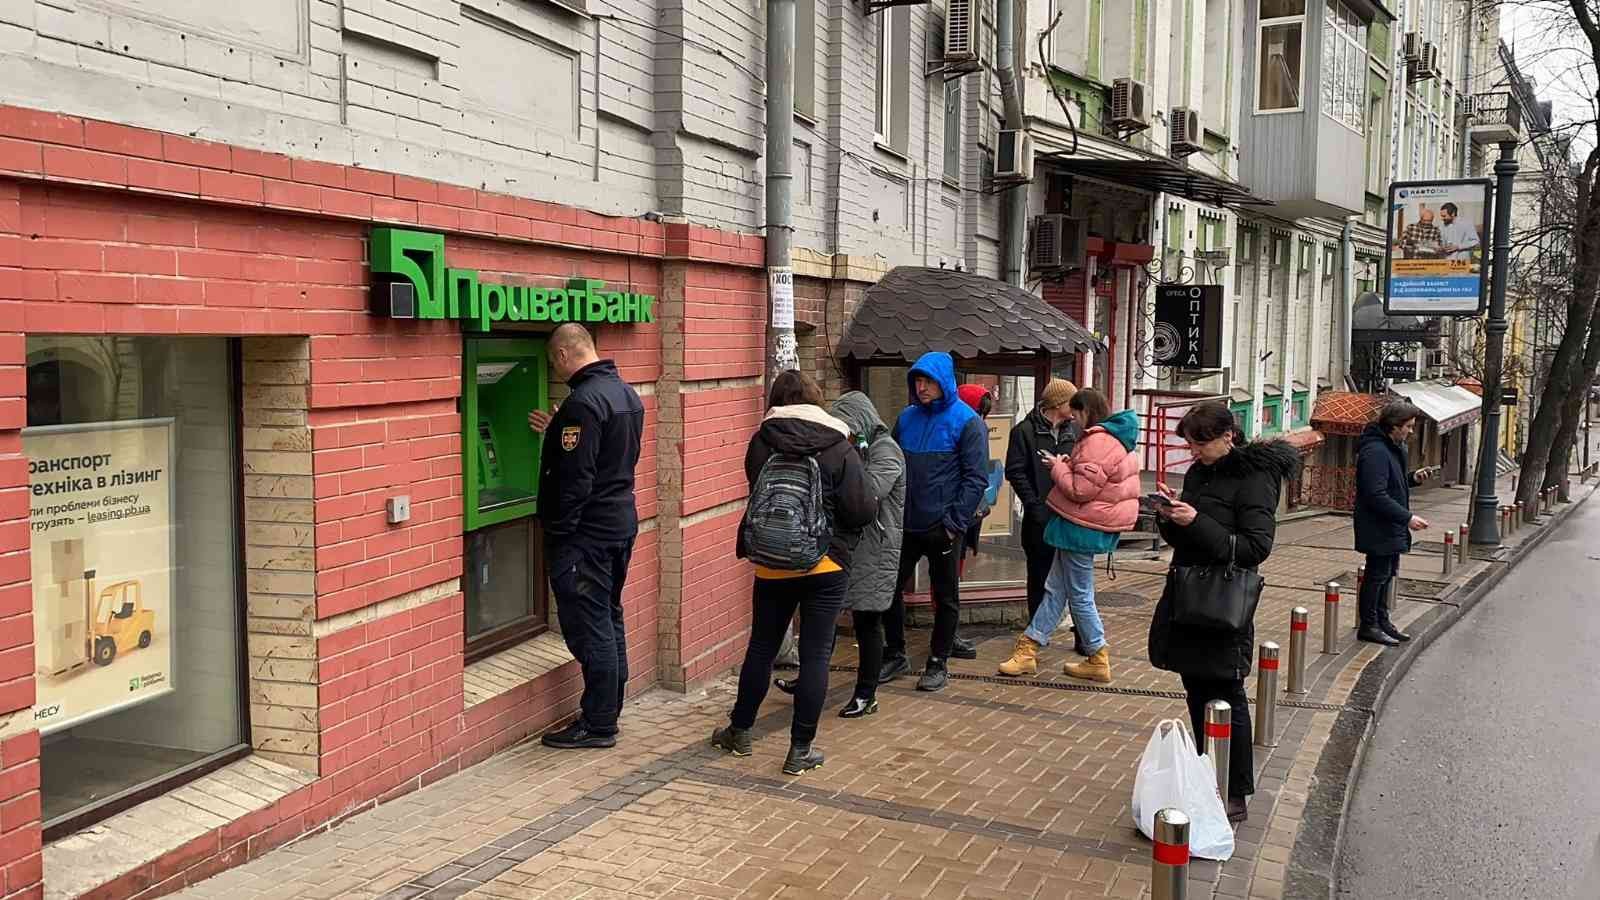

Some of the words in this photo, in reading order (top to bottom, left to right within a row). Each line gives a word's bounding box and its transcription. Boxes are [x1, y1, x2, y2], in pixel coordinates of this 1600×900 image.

[449, 268, 656, 331] ПриватБанк
[1187, 287, 1201, 365] ОПТИКА
[97, 476, 106, 489] в
[110, 469, 162, 487] лізинг
[46, 500, 101, 517] проблеми
[102, 494, 140, 508] бізнесу
[87, 504, 151, 523] leasing.pb.ua
